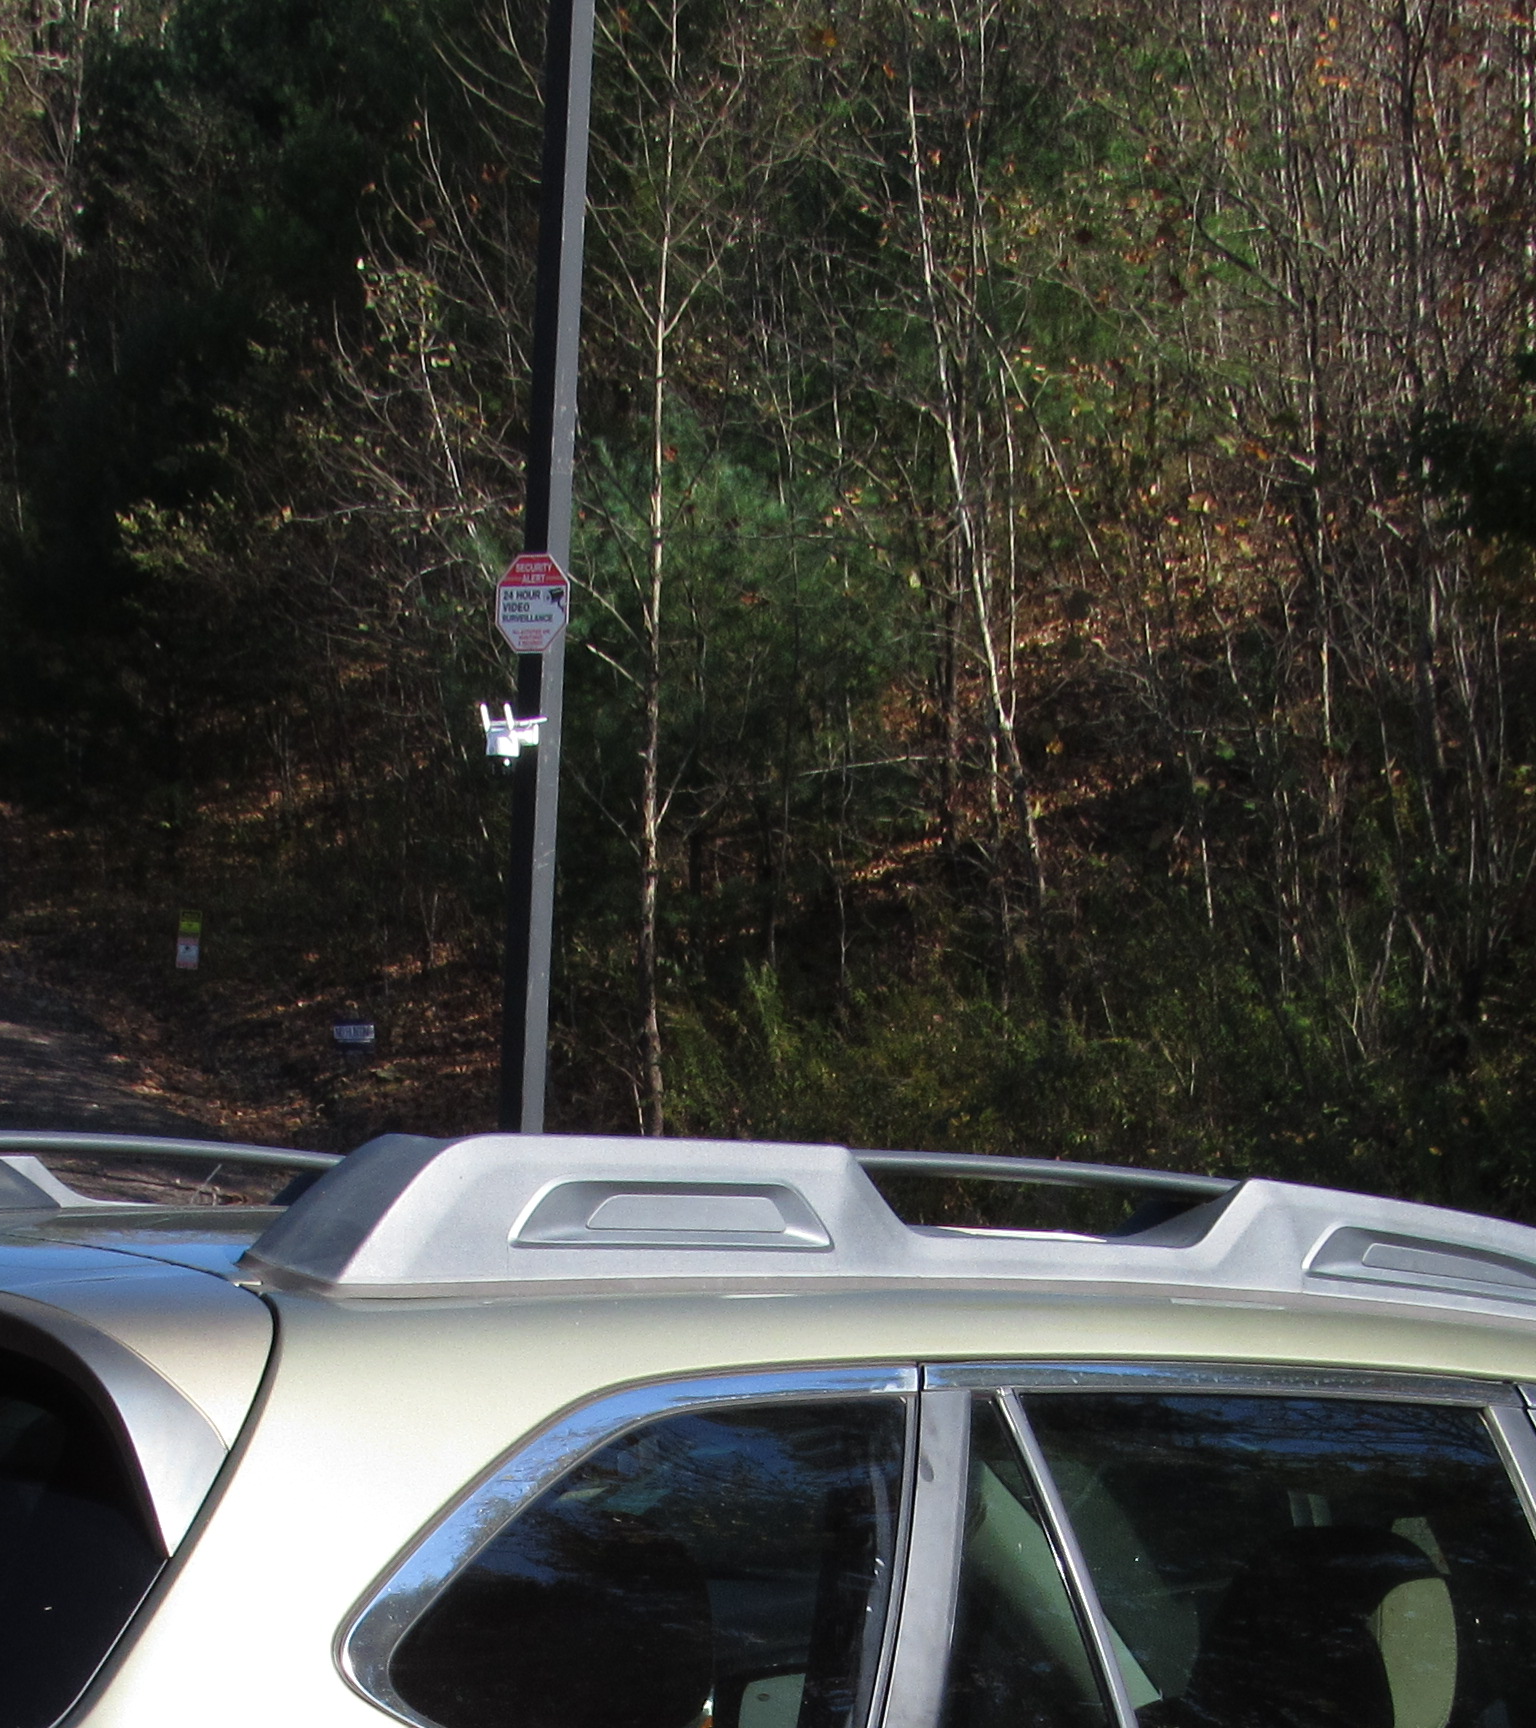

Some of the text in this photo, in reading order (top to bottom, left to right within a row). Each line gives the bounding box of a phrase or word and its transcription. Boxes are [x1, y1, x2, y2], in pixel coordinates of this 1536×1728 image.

[516, 563, 552, 573] SECURITY
[521, 574, 546, 583] ALERT
[503, 590, 541, 600] 24 HOUR
[502, 602, 530, 612] VIDEO
[502, 613, 553, 623] SURVEILLANCE
